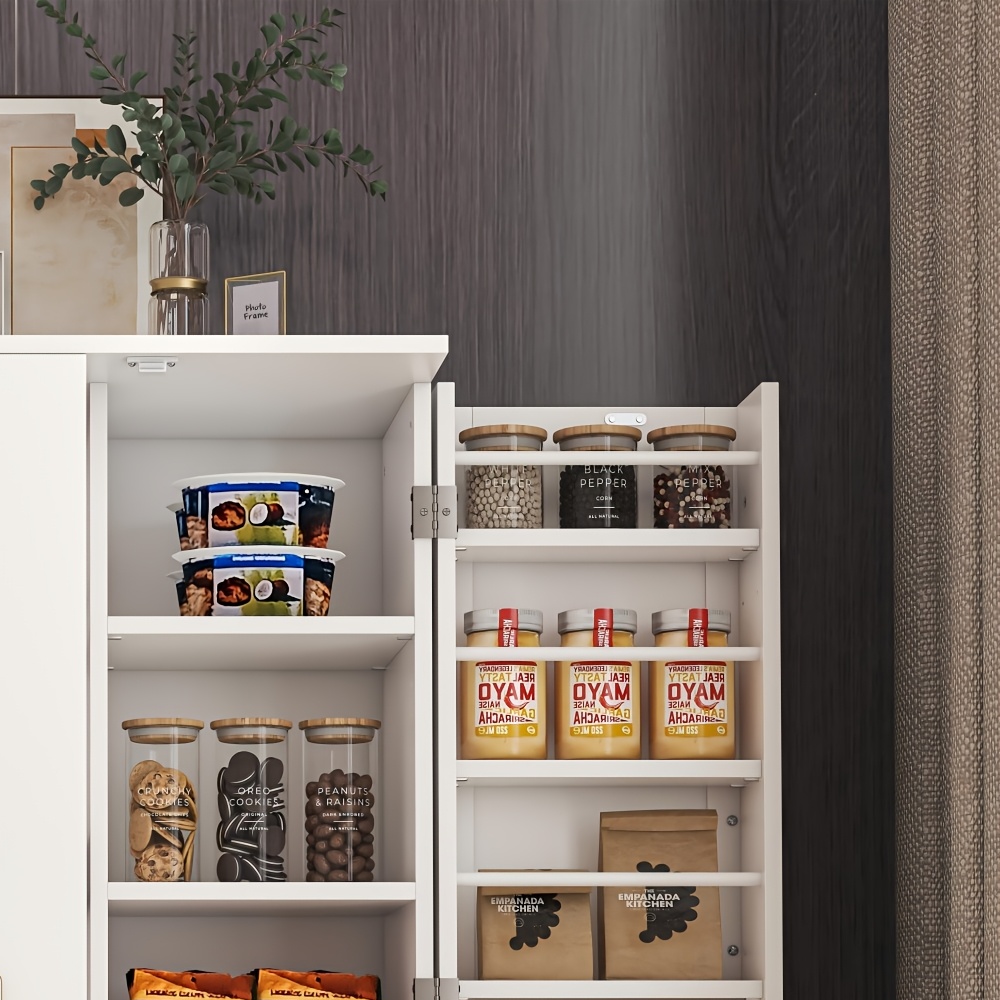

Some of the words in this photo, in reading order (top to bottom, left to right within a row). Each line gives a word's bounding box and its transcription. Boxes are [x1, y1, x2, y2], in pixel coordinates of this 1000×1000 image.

[243, 312, 269, 320] Frame
[584, 465, 624, 474] BLACK
[580, 477, 627, 488] PEPPER
[675, 477, 722, 488] PEPPER
[137, 787, 191, 795] CRUNCHY
[237, 787, 270, 795] OREO
[317, 787, 369, 795] PEANUTS
[140, 798, 190, 806] COOKIES
[230, 797, 278, 807] COOKIES
[315, 798, 321, 807] &
[326, 797, 370, 807] RAISINS
[491, 897, 545, 905] EMPANADA
[618, 893, 680, 901] EMPANADA
[498, 905, 539, 913] KITCHEN
